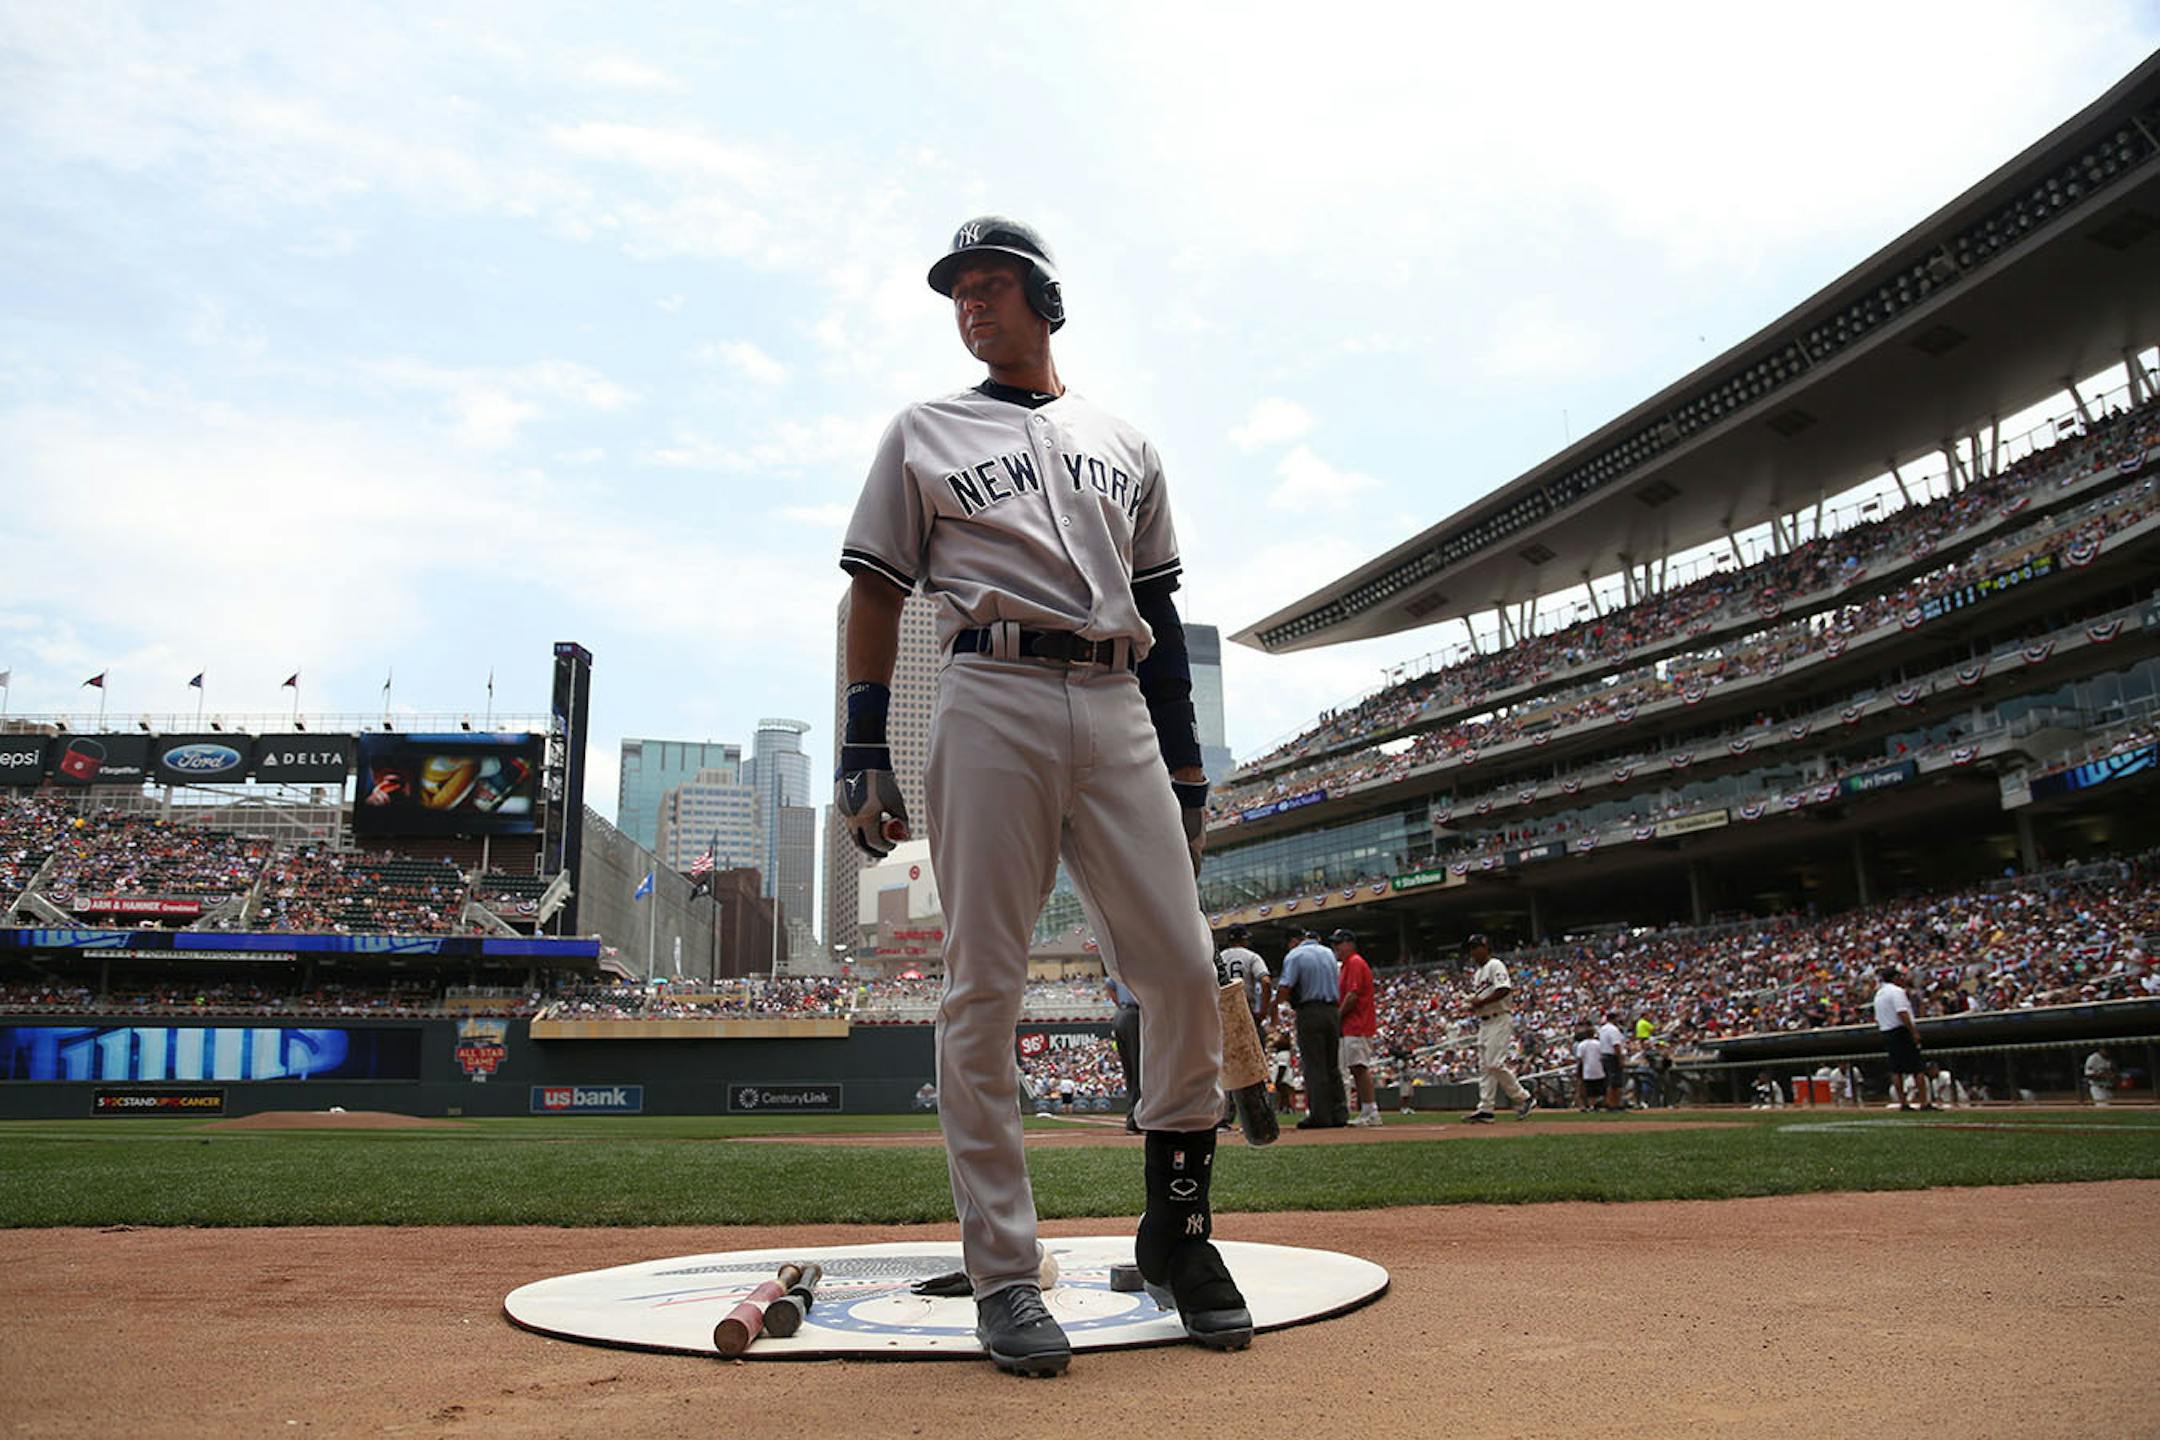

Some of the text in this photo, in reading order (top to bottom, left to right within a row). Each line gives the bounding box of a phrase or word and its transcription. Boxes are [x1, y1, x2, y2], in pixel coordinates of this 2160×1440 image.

[945, 451, 1041, 519] NEW
[177, 750, 226, 768] Ford
[283, 753, 343, 764] DELTA
[90, 900, 111, 910] ARM
[761, 1092, 829, 1105] CenturyLink
[1185, 1213, 1205, 1235] NY
